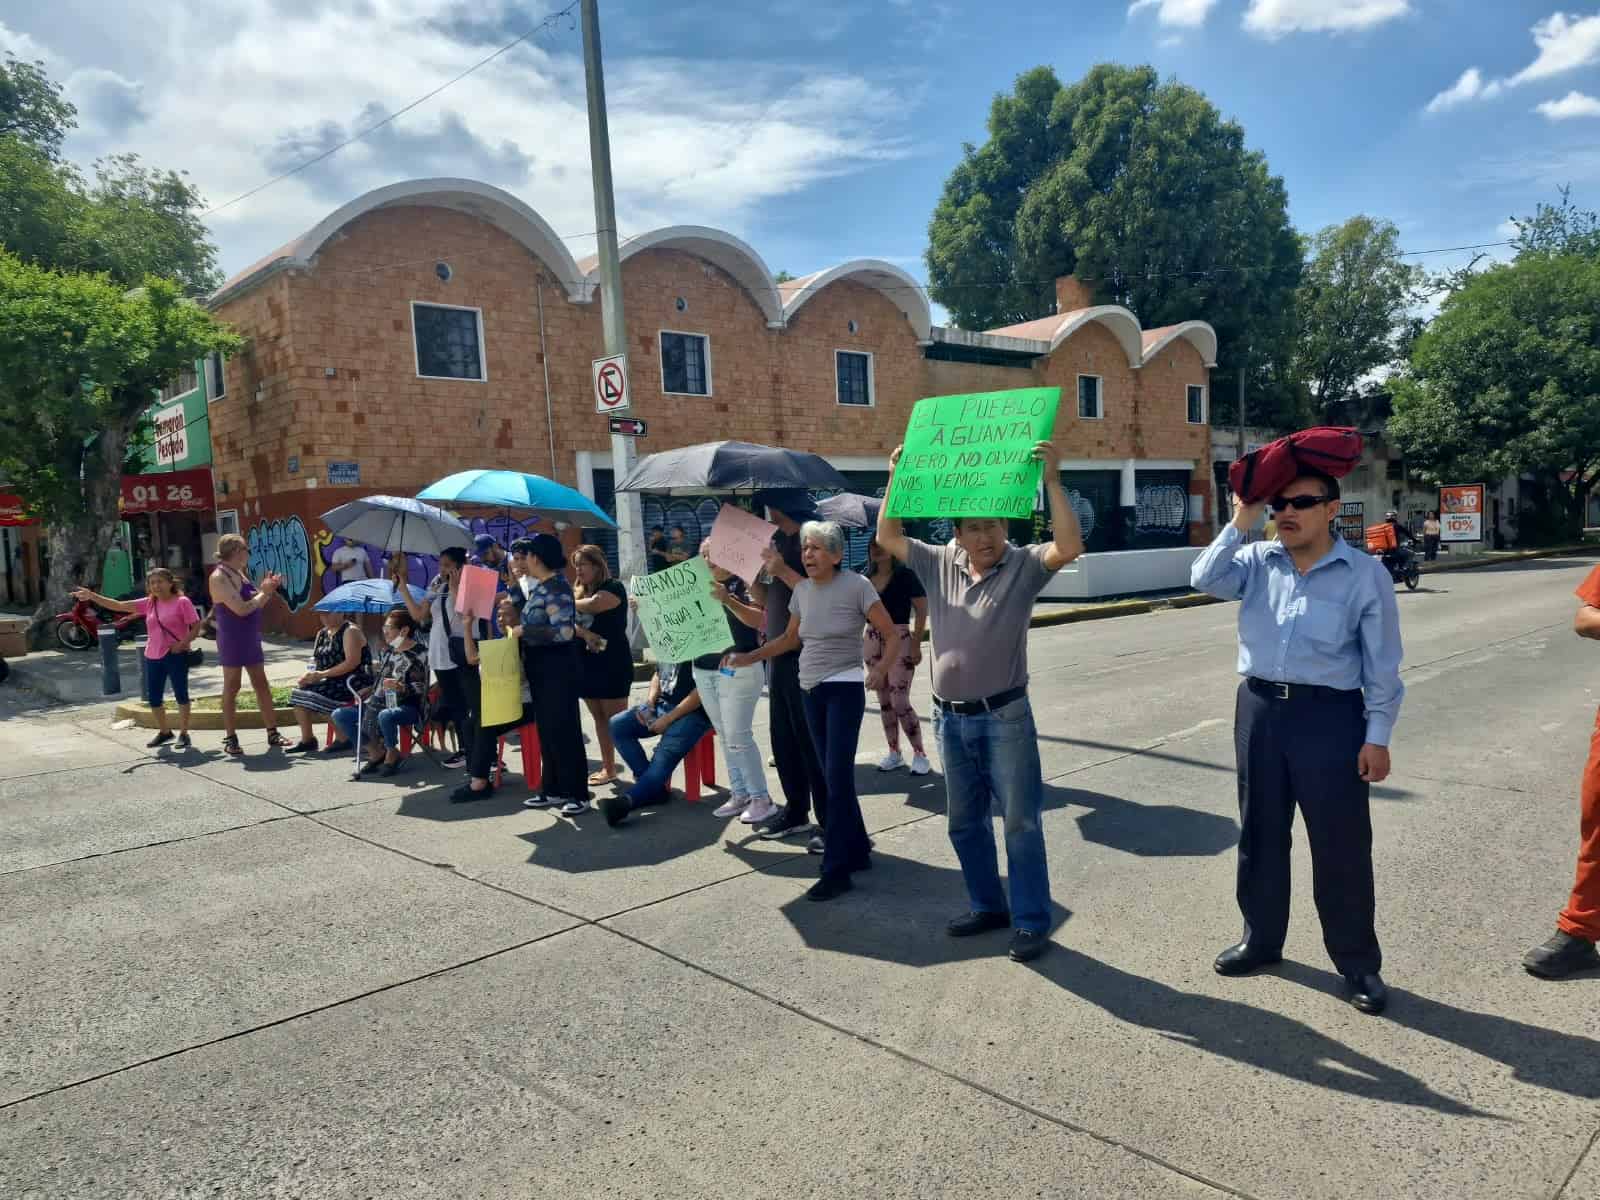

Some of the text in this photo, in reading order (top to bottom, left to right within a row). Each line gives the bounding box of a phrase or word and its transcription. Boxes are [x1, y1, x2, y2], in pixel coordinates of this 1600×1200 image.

[912, 398, 1047, 428] EL PUEBLO
[903, 453, 947, 470] PERO
[954, 451, 982, 469] NO
[895, 472, 1026, 491] NOS VEMOS EN
[132, 485, 192, 501] 01 26
[891, 496, 1033, 518] LAS ELECCIONES
[1447, 520, 1472, 531] 10%
